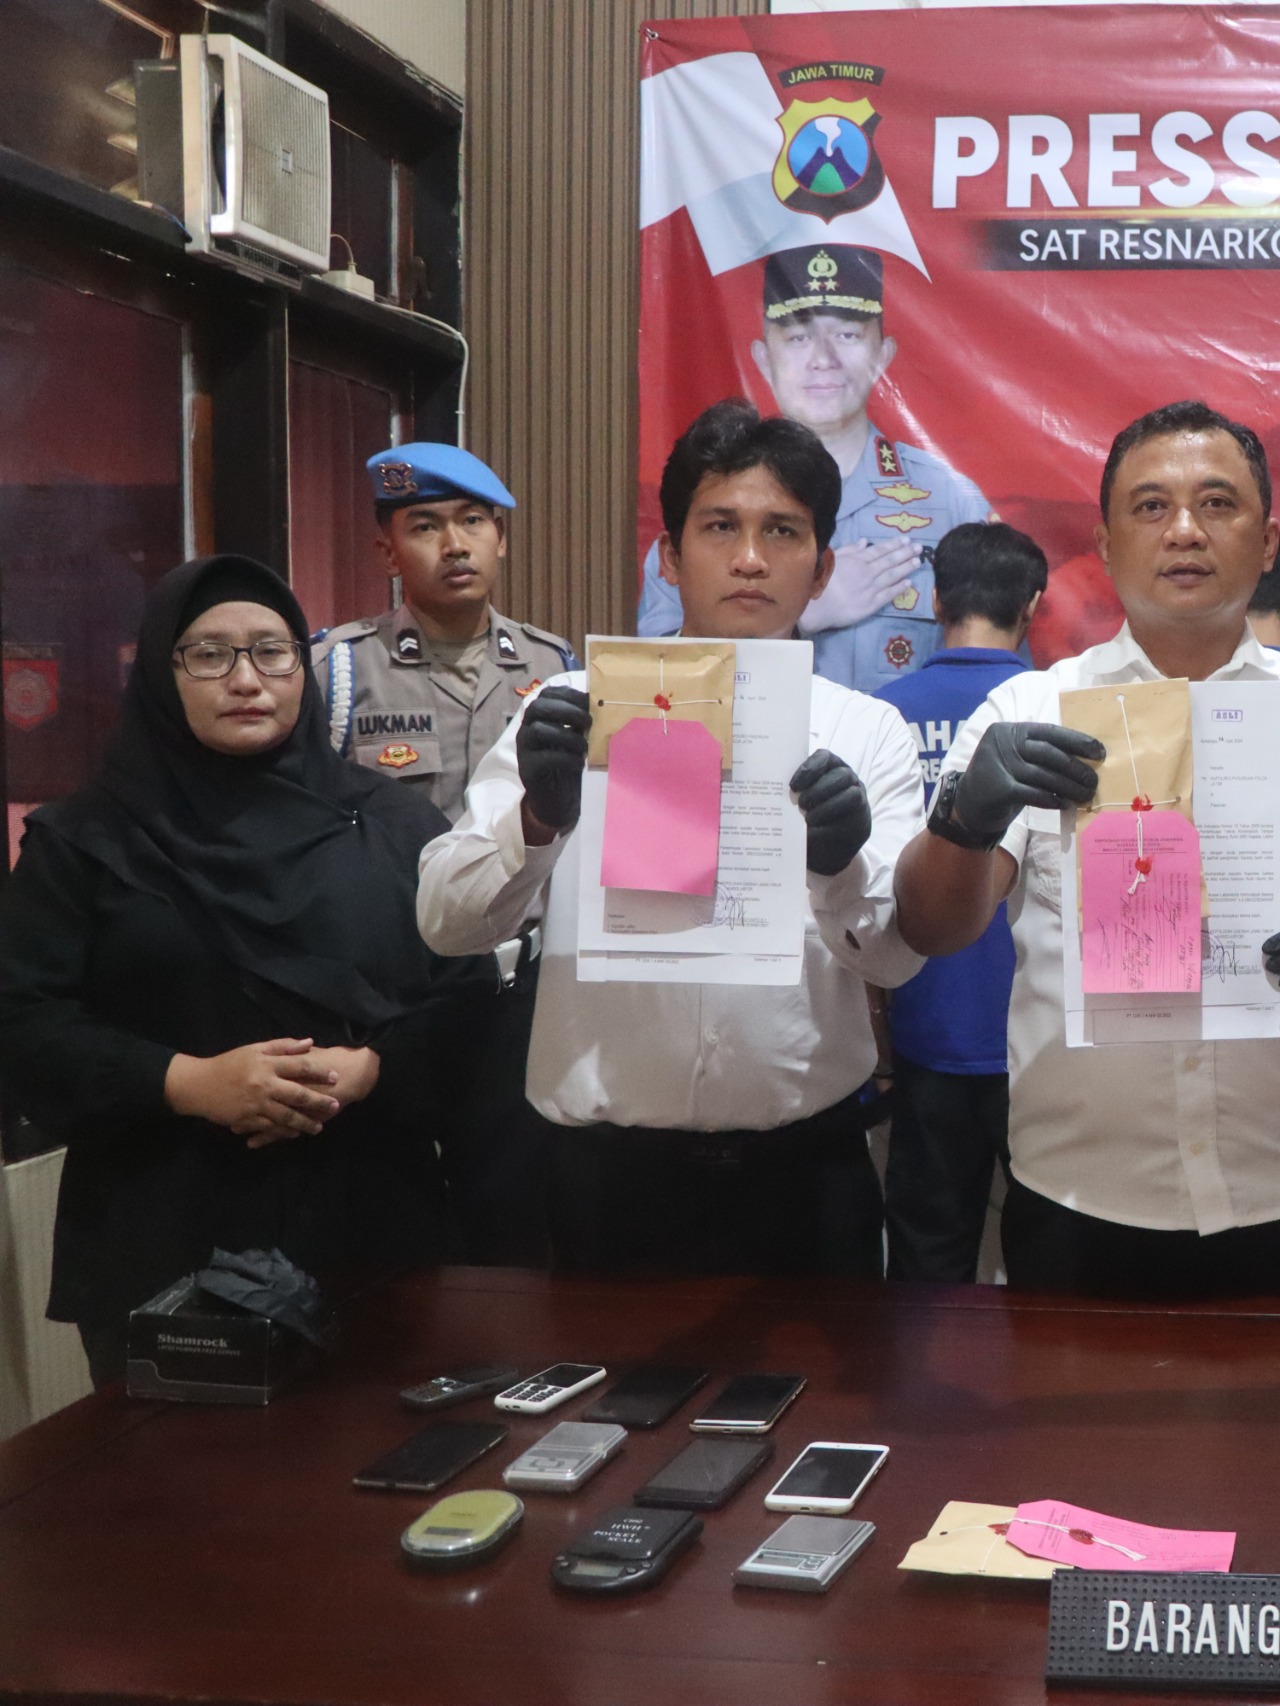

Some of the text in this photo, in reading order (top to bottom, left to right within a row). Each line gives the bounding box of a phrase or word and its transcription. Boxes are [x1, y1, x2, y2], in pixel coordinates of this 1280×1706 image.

[788, 65, 874, 84] JAWA TIMUR
[1019, 229, 1086, 261] SAT
[358, 713, 432, 735] LUKMAN
[158, 1334, 228, 1348] Shamrock
[1106, 1600, 1280, 1655] BARANG
